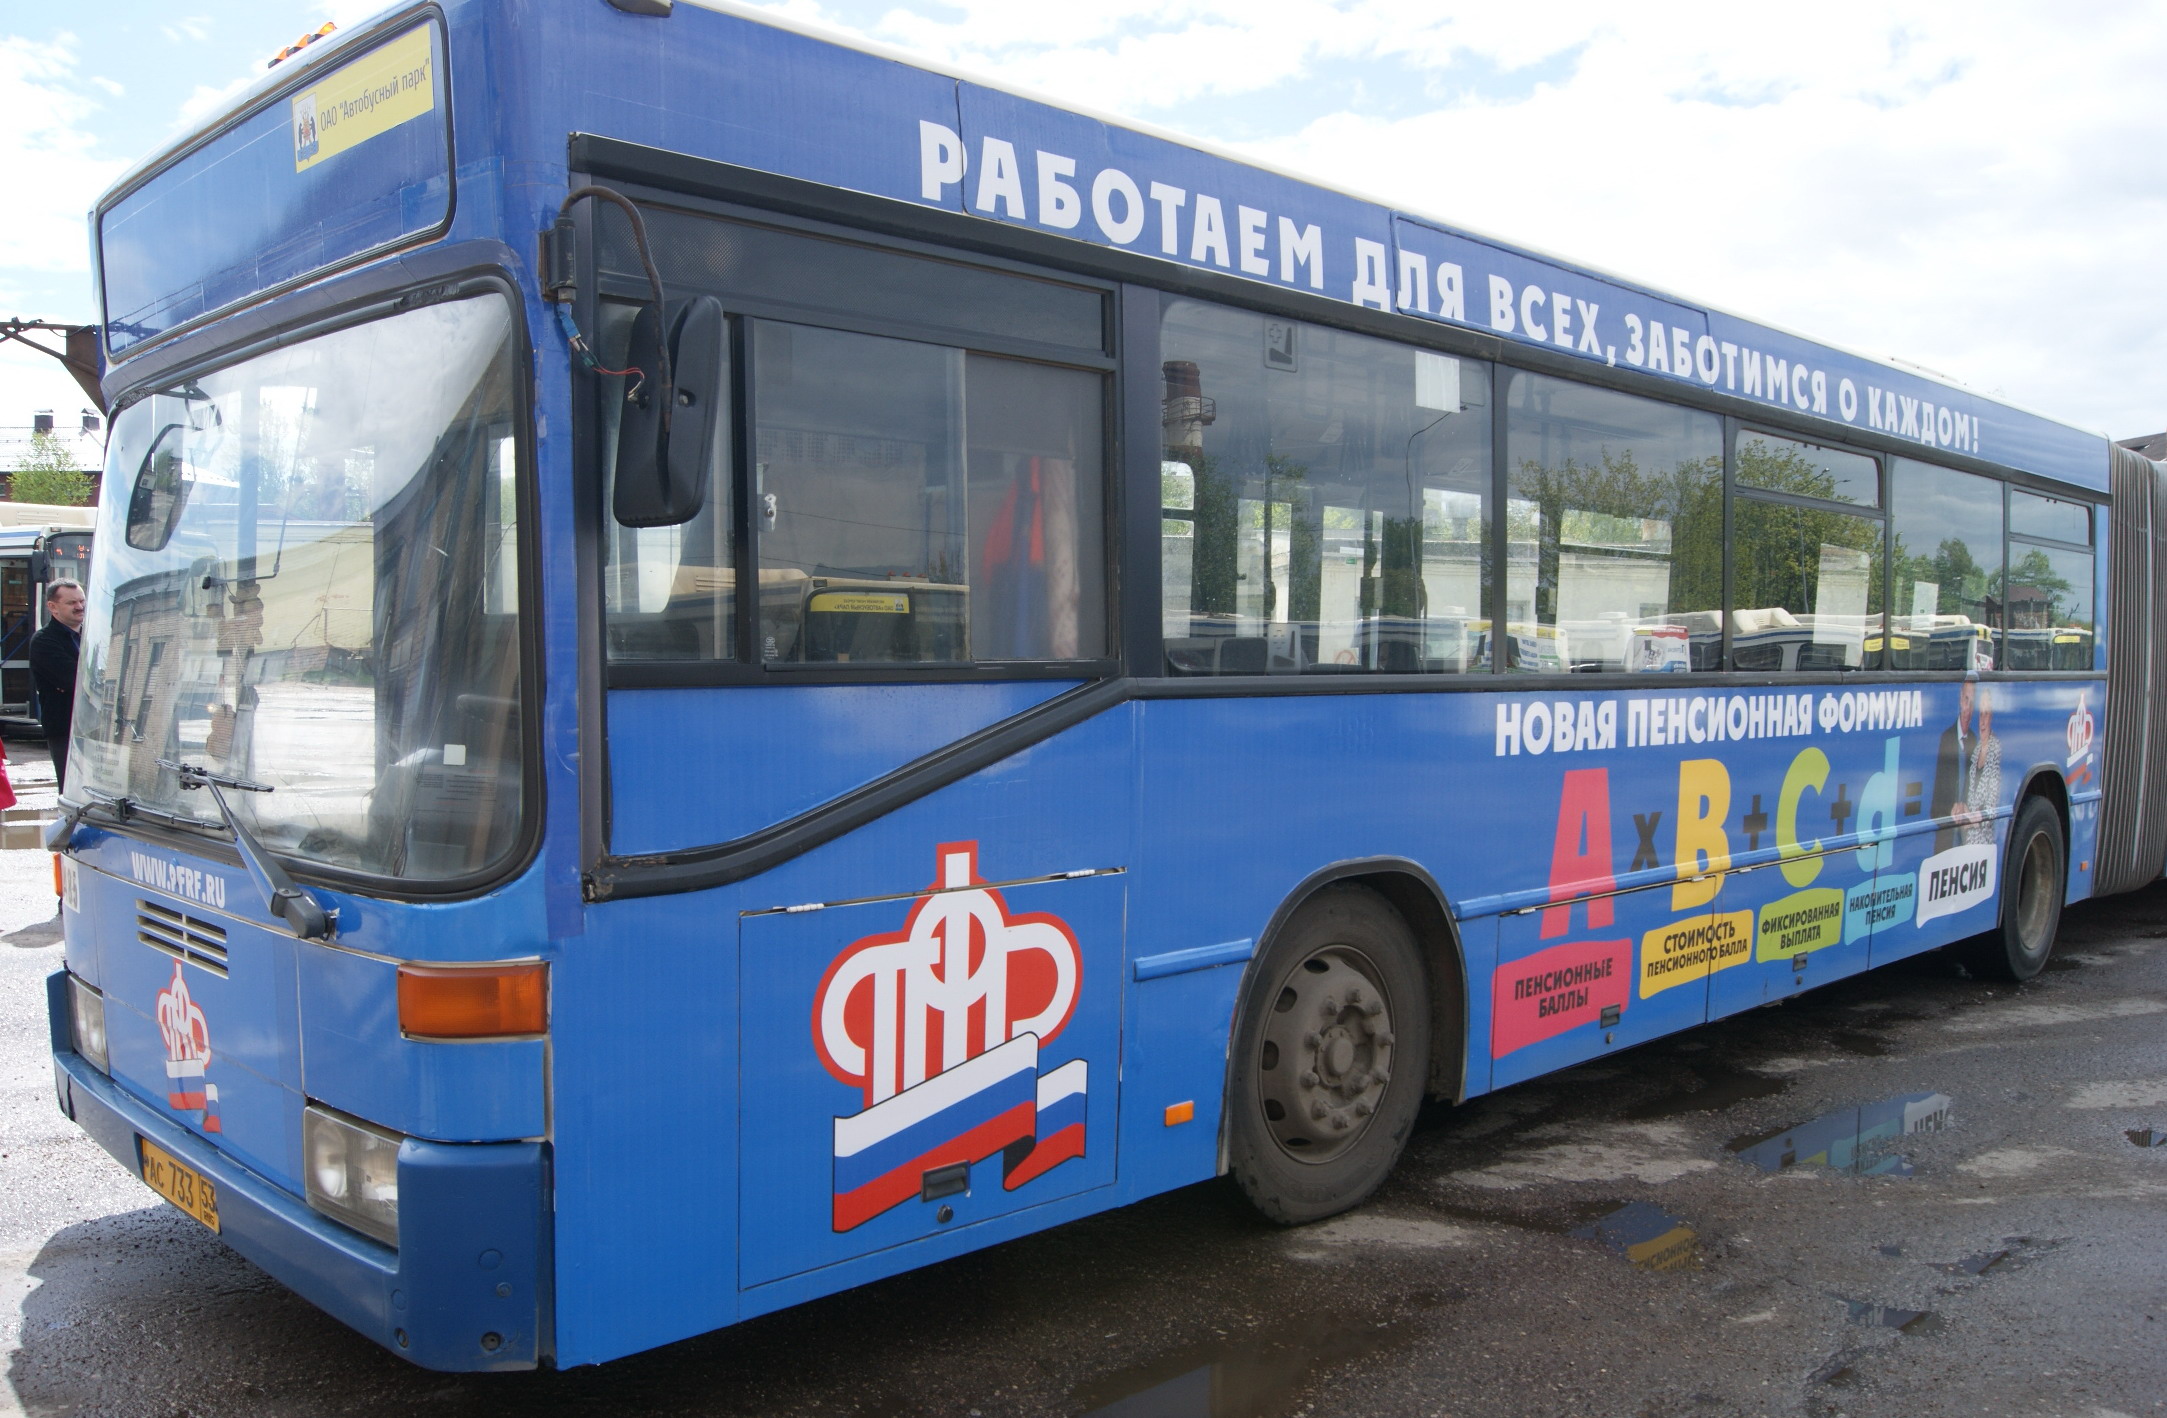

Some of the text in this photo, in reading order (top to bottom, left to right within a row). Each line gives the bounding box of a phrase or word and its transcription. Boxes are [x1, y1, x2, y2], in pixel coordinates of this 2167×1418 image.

[320, 105, 338, 131] ОАО
[919, 119, 1979, 454] РАБОТАЕМ ДЛЯ ВСЕХ, ЗАБОТИМСЯ О КАЖДОМ!
[1496, 690, 1923, 757] НОВАЯ ПЕНСИОННАЯ ФОРМУЛА
[131, 851, 226, 909] WWW.PFRF.RU
[1849, 883, 1913, 912] НАКОПИТЕЛЬНАЯ
[1928, 858, 1988, 902] ПЕНСИЯ
[1761, 902, 1840, 936] ФИКСИРОВАННАЯ
[1865, 904, 1896, 926] ПЕНСИЯ
[1663, 921, 1736, 955] СТОИМОСТЬ
[1780, 924, 1822, 950] ВЫПЛАТА
[1647, 938, 1748, 978] ПЕНСИОННОГО БАЛЛА
[1514, 957, 1614, 1000] ПЕНСИОННЫЕ
[1538, 987, 1589, 1019] БАЛЛЫ
[168, 1160, 194, 1209] 733
[201, 1179, 216, 1213] 53
